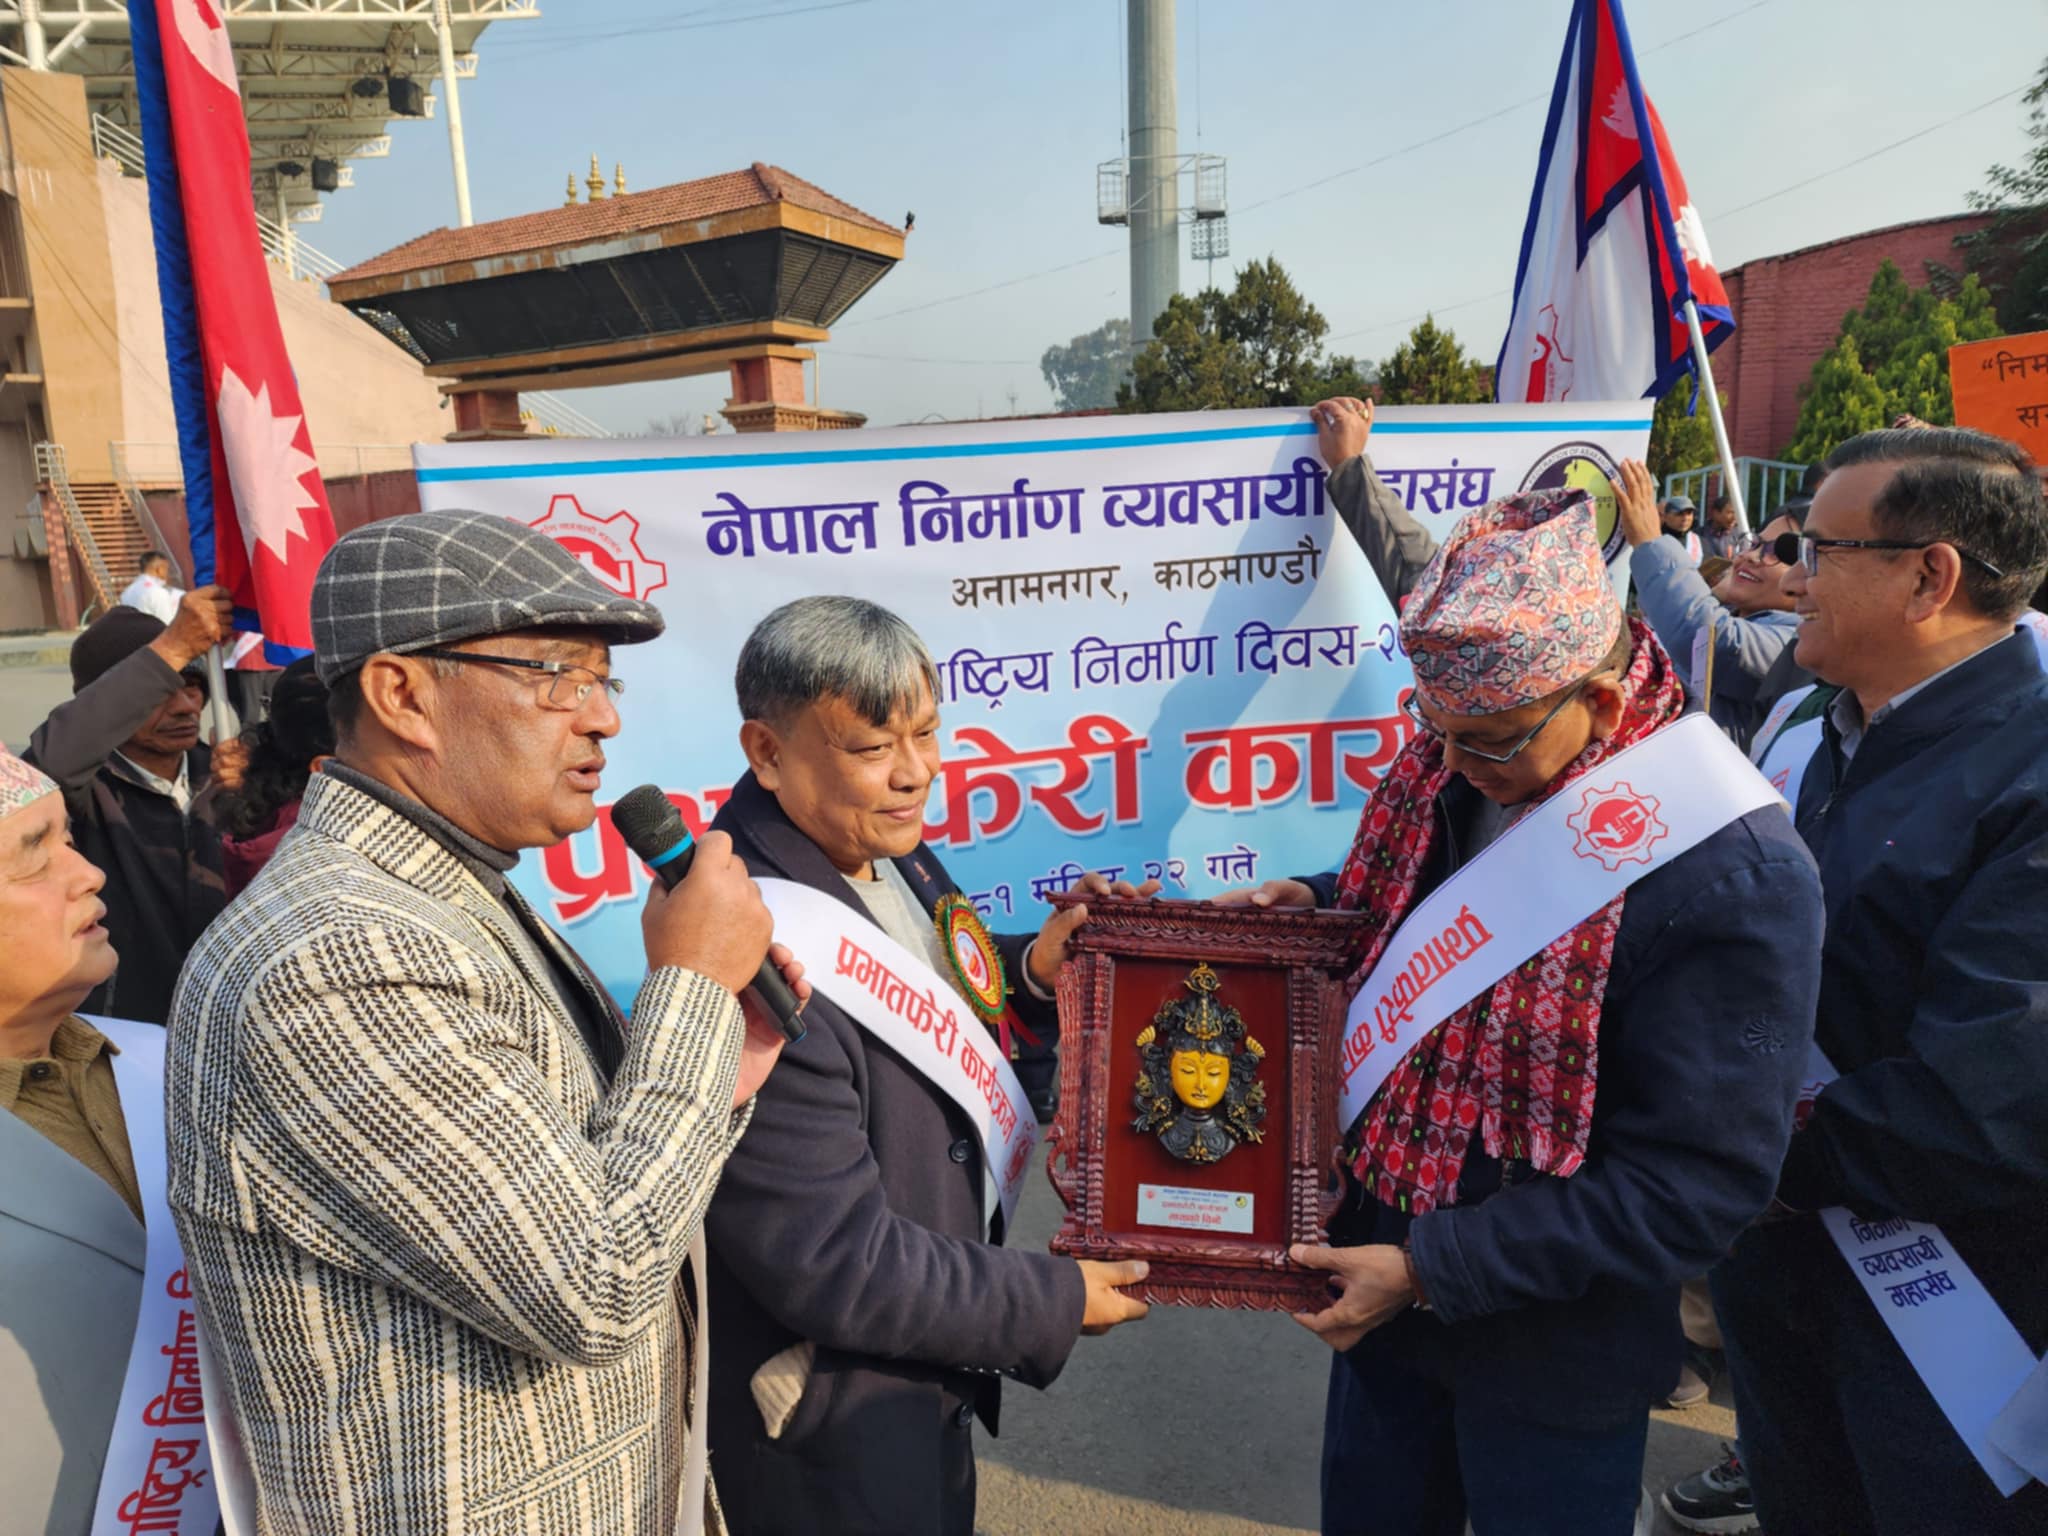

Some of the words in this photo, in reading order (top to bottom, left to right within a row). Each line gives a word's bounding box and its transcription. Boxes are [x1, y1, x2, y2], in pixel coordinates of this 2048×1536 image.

[702, 491, 879, 558] नेपाल
[898, 478, 1085, 547] निर्माण
[1102, 456, 1328, 528] व्यवसायी
[1375, 458, 1496, 514] हासंघ
[952, 565, 1129, 609] अनामनगर,
[1153, 534, 1322, 592] काठमाण्डौ
[1071, 621, 1219, 690] निर्माण
[1235, 621, 1408, 674] दिवस-२
[1145, 860, 1187, 890] २२
[1206, 844, 1258, 882] गते
[1374, 904, 1494, 1044] प्रभातफेरी
[834, 935, 959, 1058] प्रभातफेरी
[960, 1037, 1019, 1144] कार्यक्रम
[1858, 1234, 1944, 1277] व्यवसायी
[1884, 1270, 1957, 1308] महासंघ
